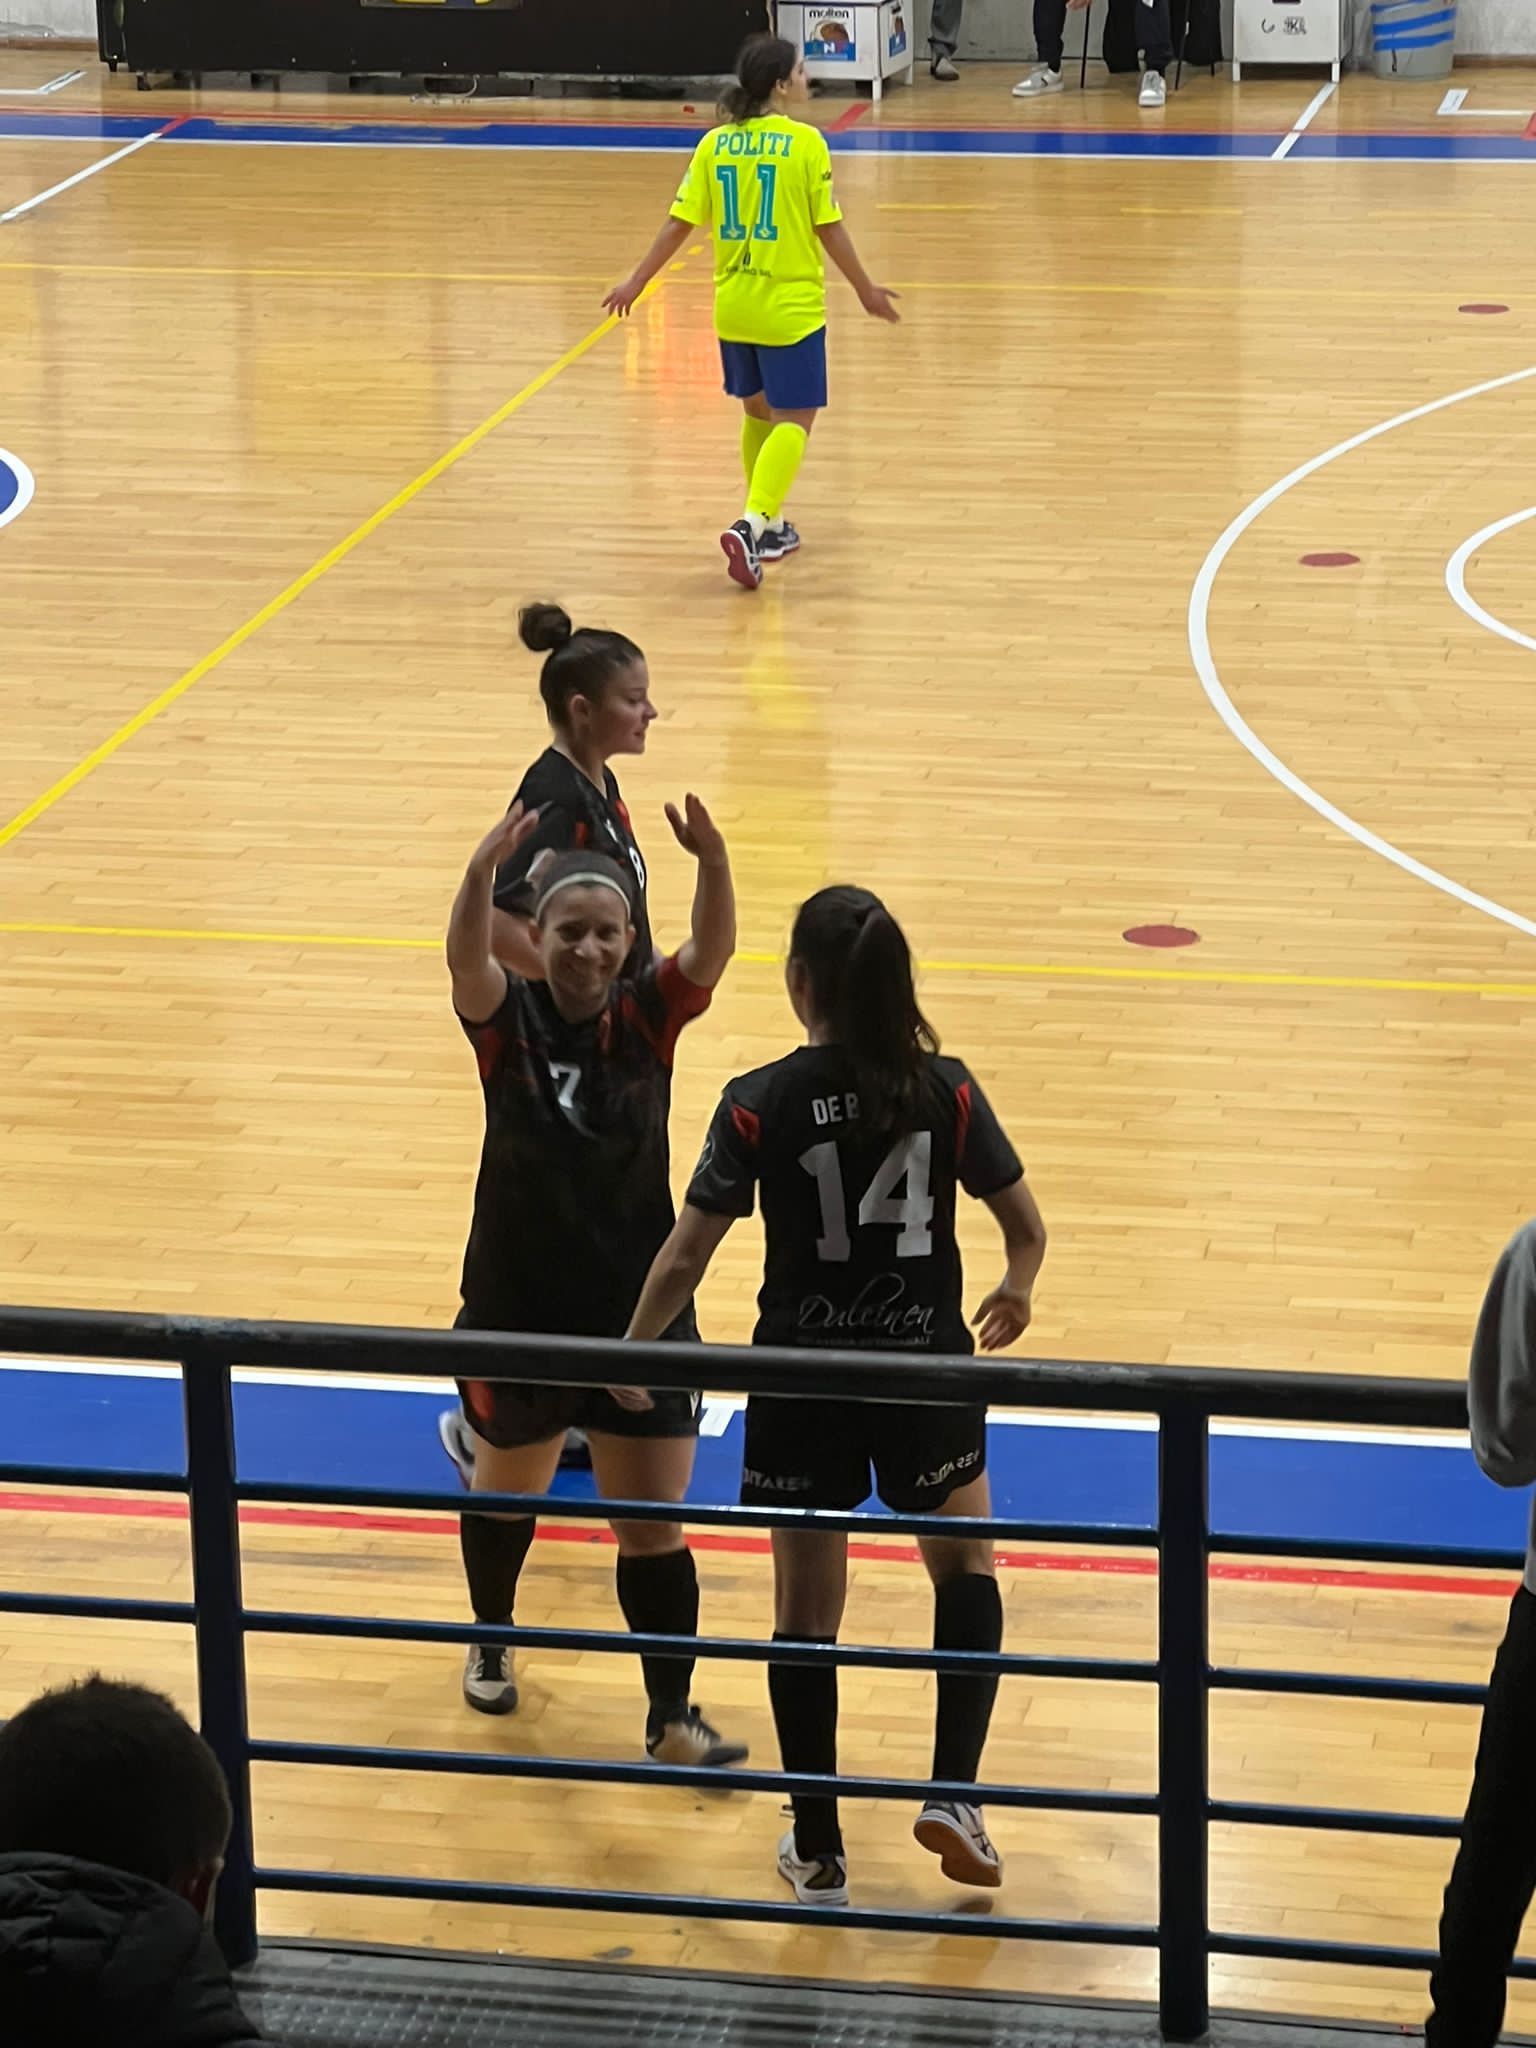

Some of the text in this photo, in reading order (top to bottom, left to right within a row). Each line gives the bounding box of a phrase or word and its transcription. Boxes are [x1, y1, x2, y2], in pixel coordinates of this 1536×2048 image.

[809, 8, 849, 18] molten
[714, 131, 793, 157] POLITI
[716, 163, 778, 241] 11
[629, 847, 645, 889] 8
[548, 1061, 581, 1109] 7
[811, 1096, 842, 1126] DE
[798, 1130, 934, 1262] 14
